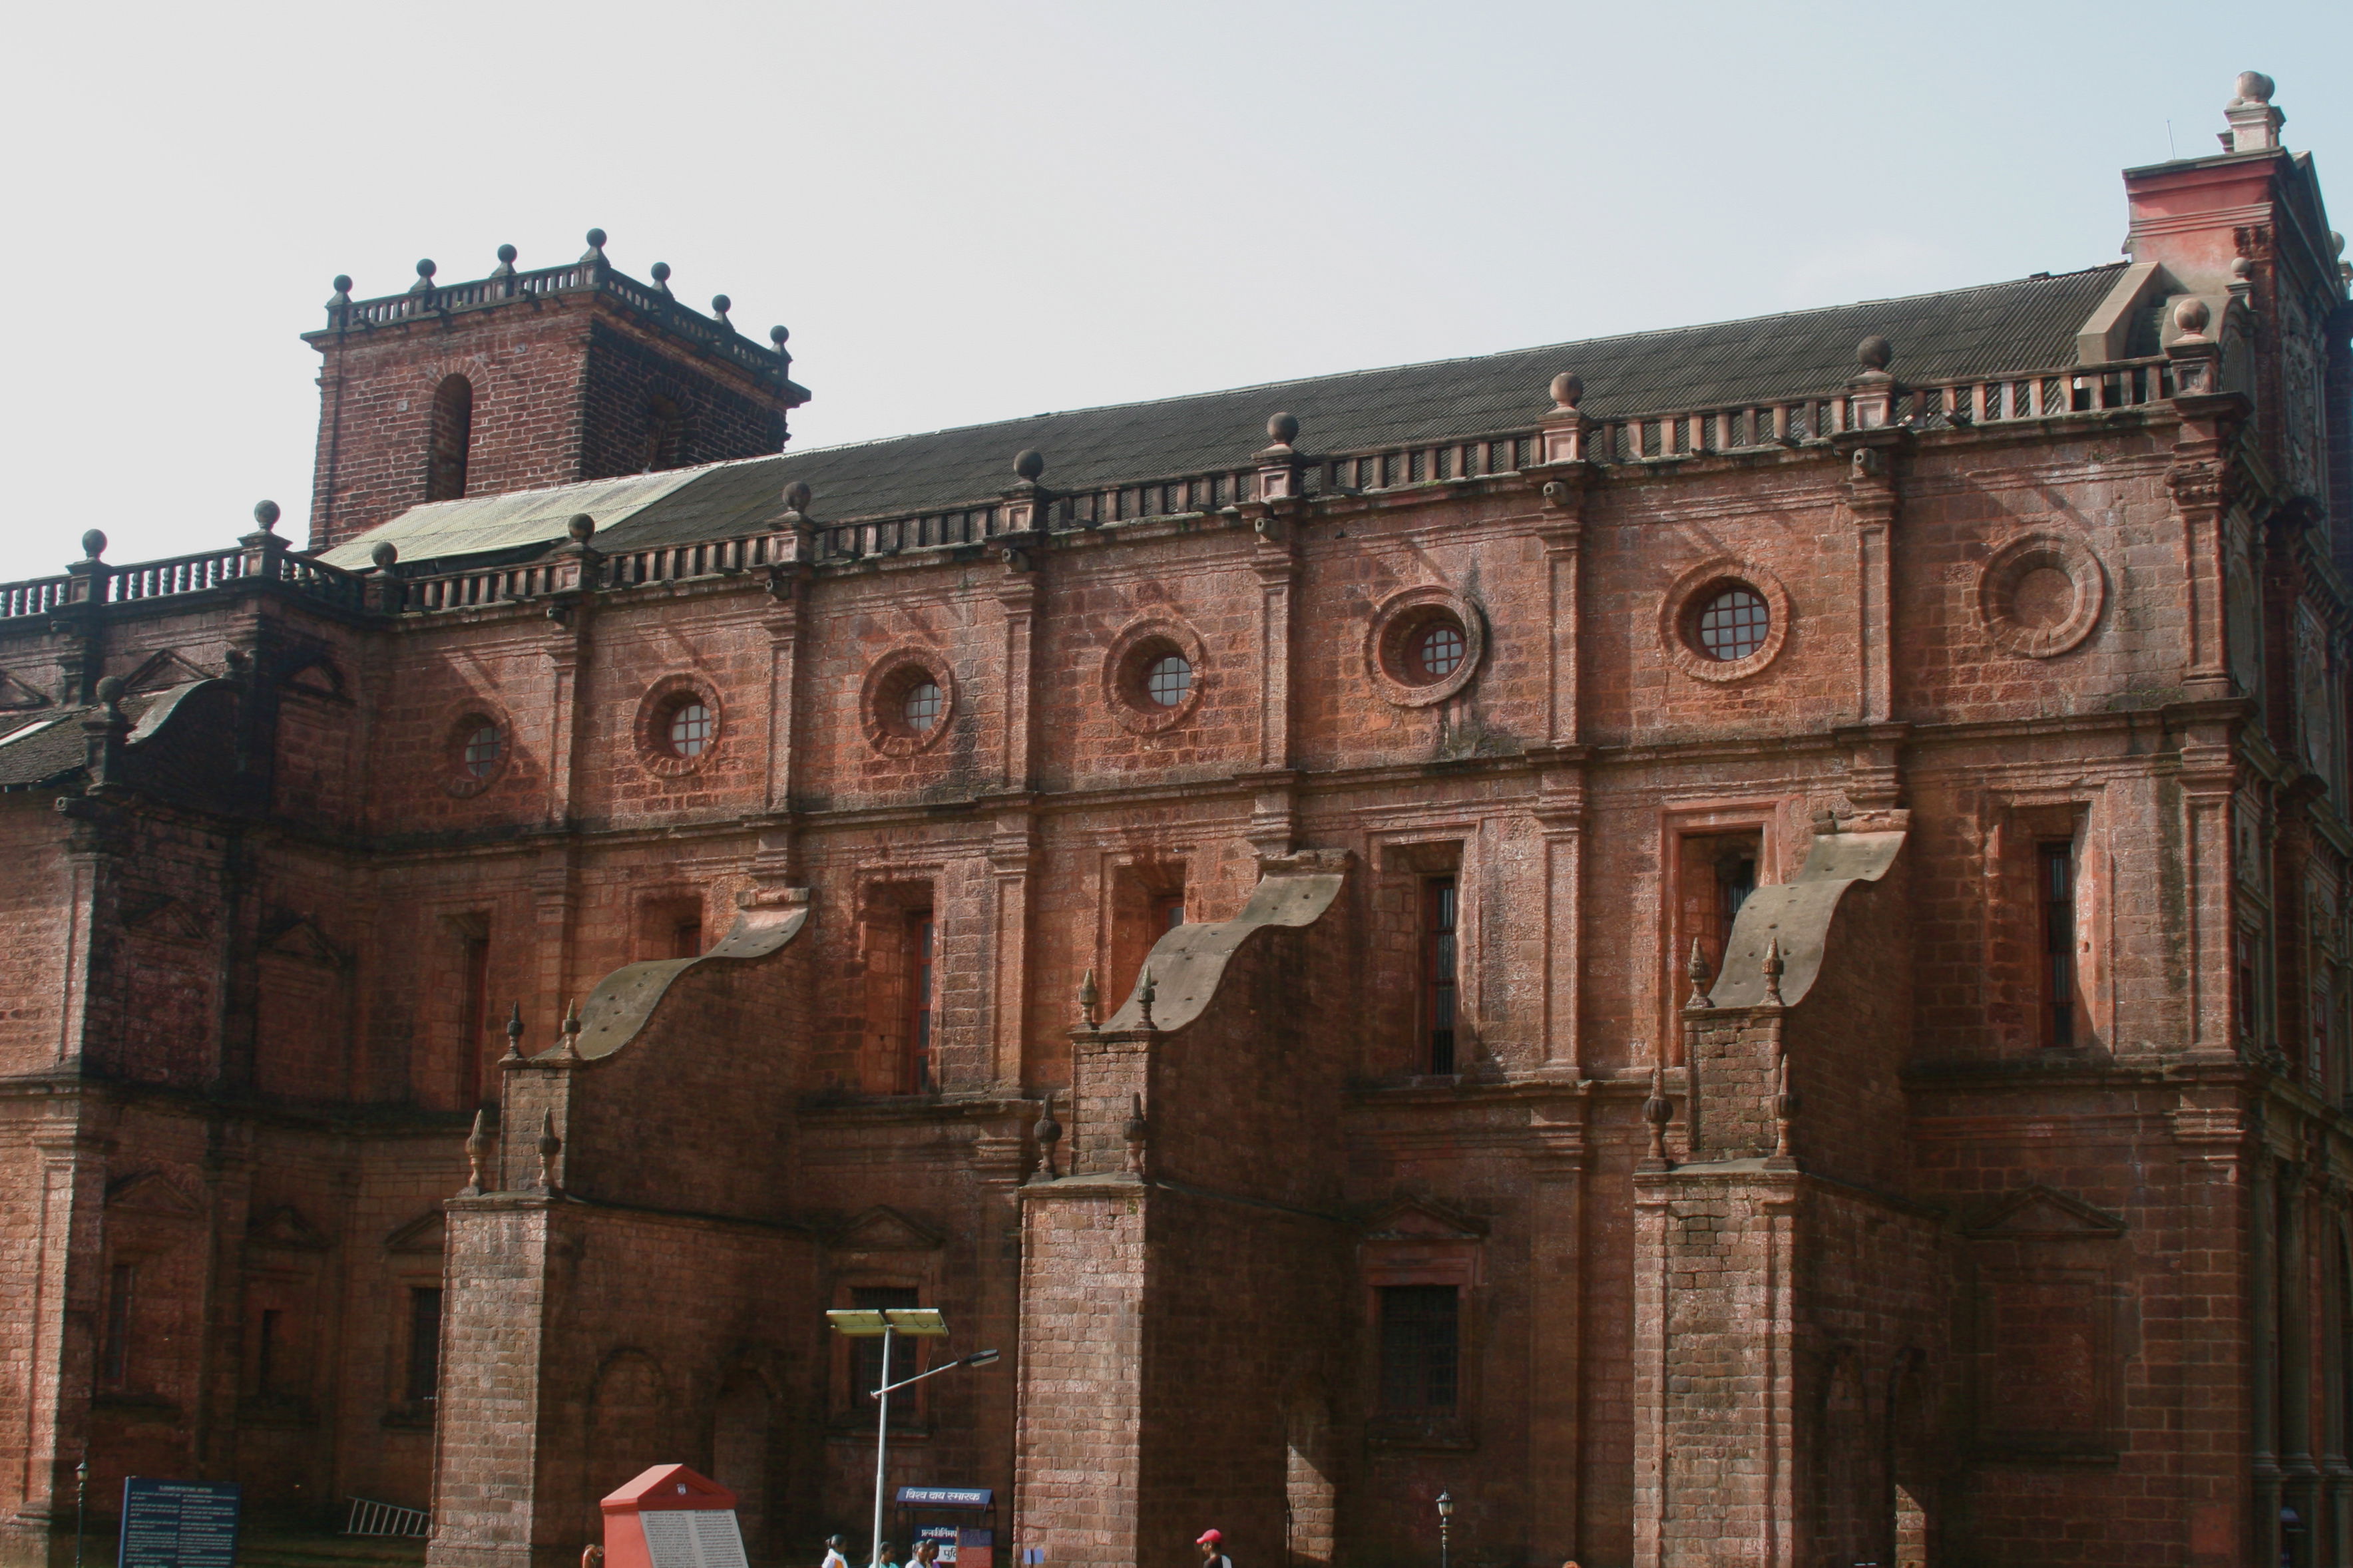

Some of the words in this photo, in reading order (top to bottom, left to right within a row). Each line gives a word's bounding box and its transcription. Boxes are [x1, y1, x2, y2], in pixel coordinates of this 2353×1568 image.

[906, 1488, 927, 1499] विश्व
[929, 1491, 946, 1500] दाय
[947, 1491, 980, 1501] स्मारक
